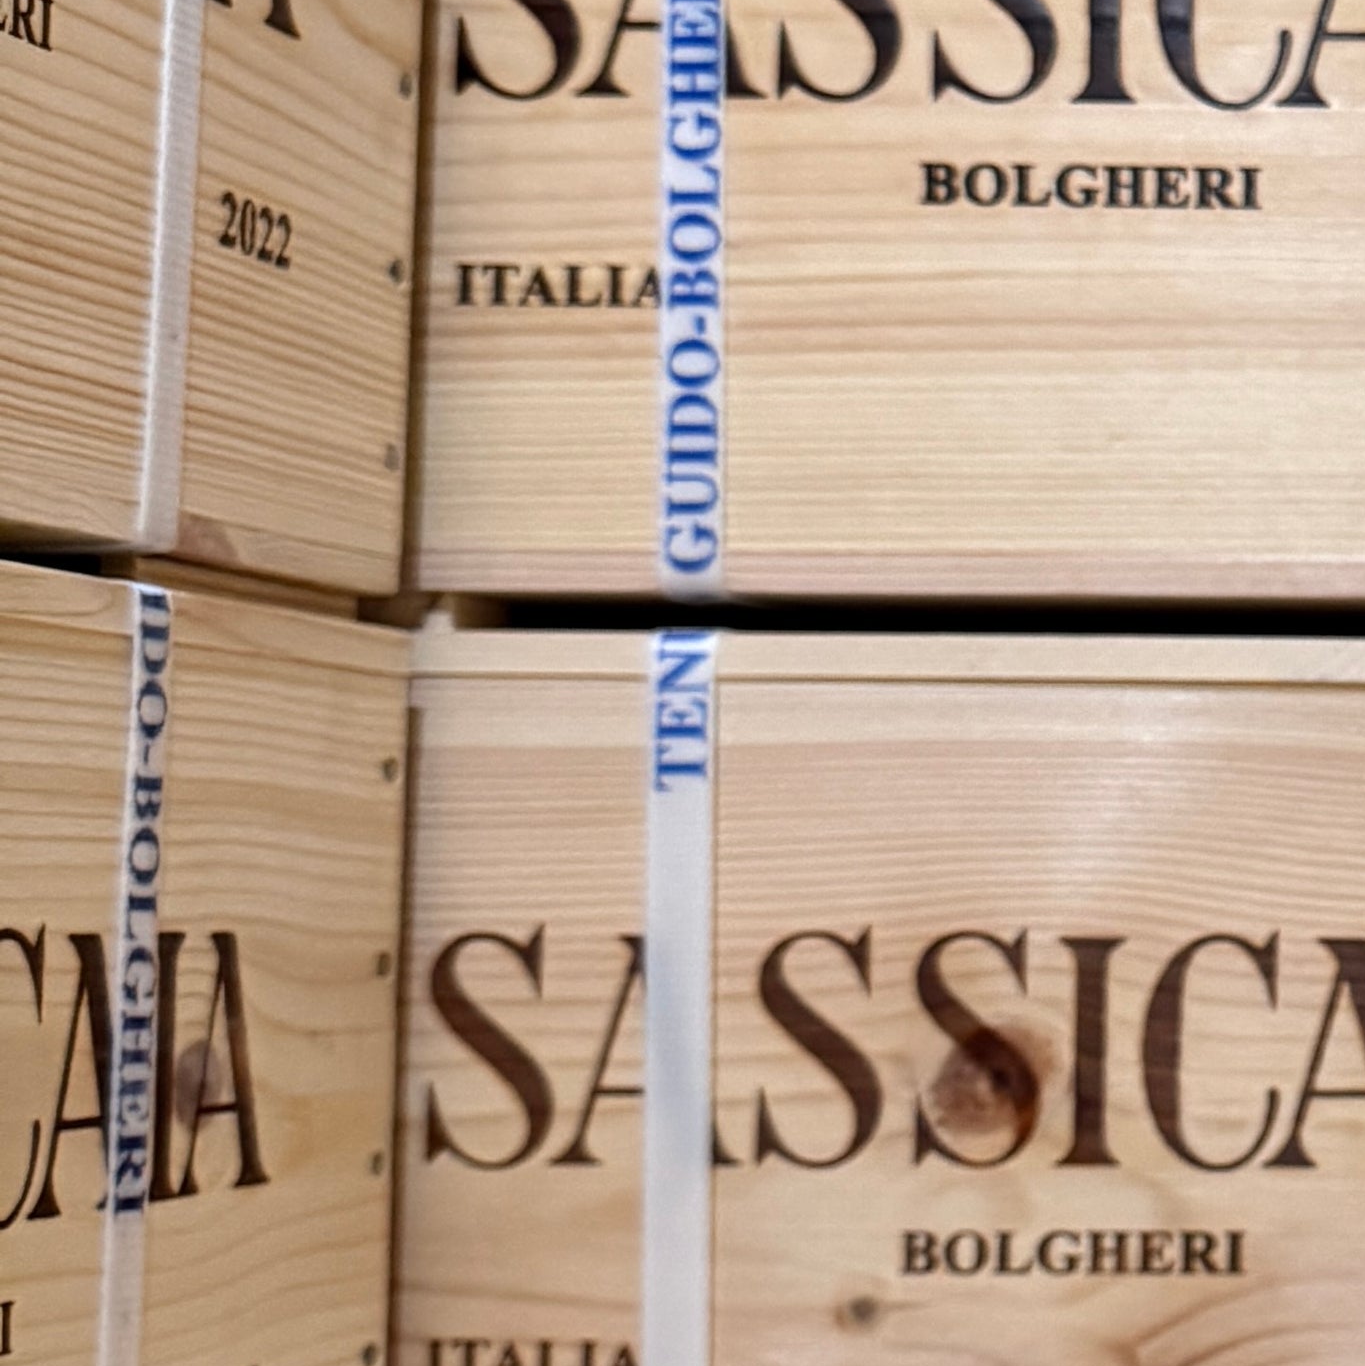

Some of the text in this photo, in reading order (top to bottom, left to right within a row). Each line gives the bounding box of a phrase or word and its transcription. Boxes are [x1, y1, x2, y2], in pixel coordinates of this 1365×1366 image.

[919, 162, 1263, 210] BOLGHERI
[219, 191, 293, 270] 2022
[901, 1230, 1247, 1277] BOLGHERI
